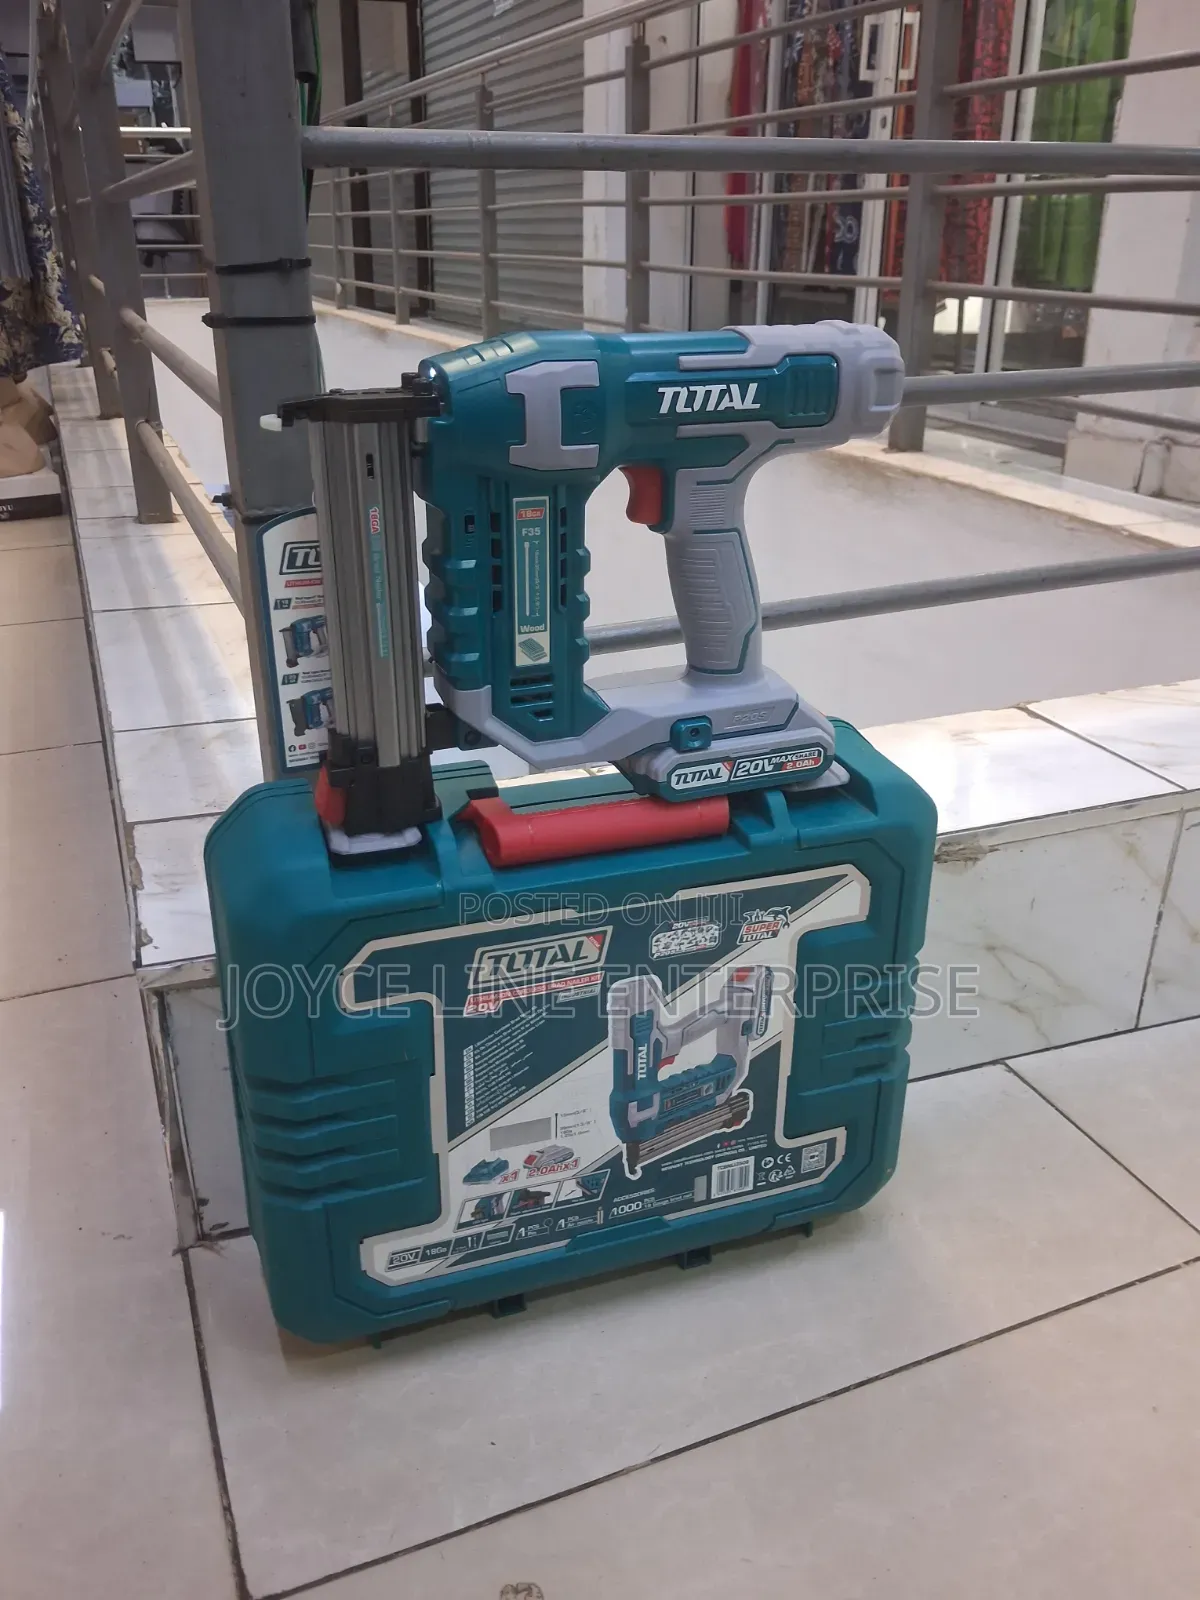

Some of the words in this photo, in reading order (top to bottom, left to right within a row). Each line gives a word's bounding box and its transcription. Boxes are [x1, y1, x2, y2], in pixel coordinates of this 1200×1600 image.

[657, 382, 761, 414] TOTAL
[369, 506, 381, 535] 18GA
[521, 527, 541, 537] F35
[520, 624, 545, 633] Wood
[736, 758, 775, 777] 20V
[785, 759, 815, 770] 2.0Ah
[674, 765, 724, 786] TOTAL
[744, 921, 781, 934] SUPER
[742, 930, 774, 942] TOTAL
[482, 940, 589, 978] TOTAL
[465, 1000, 500, 1014] 20V
[637, 1043, 648, 1081] TOTAL
[611, 1200, 643, 1216] 1000
[392, 1252, 416, 1264] 20V
